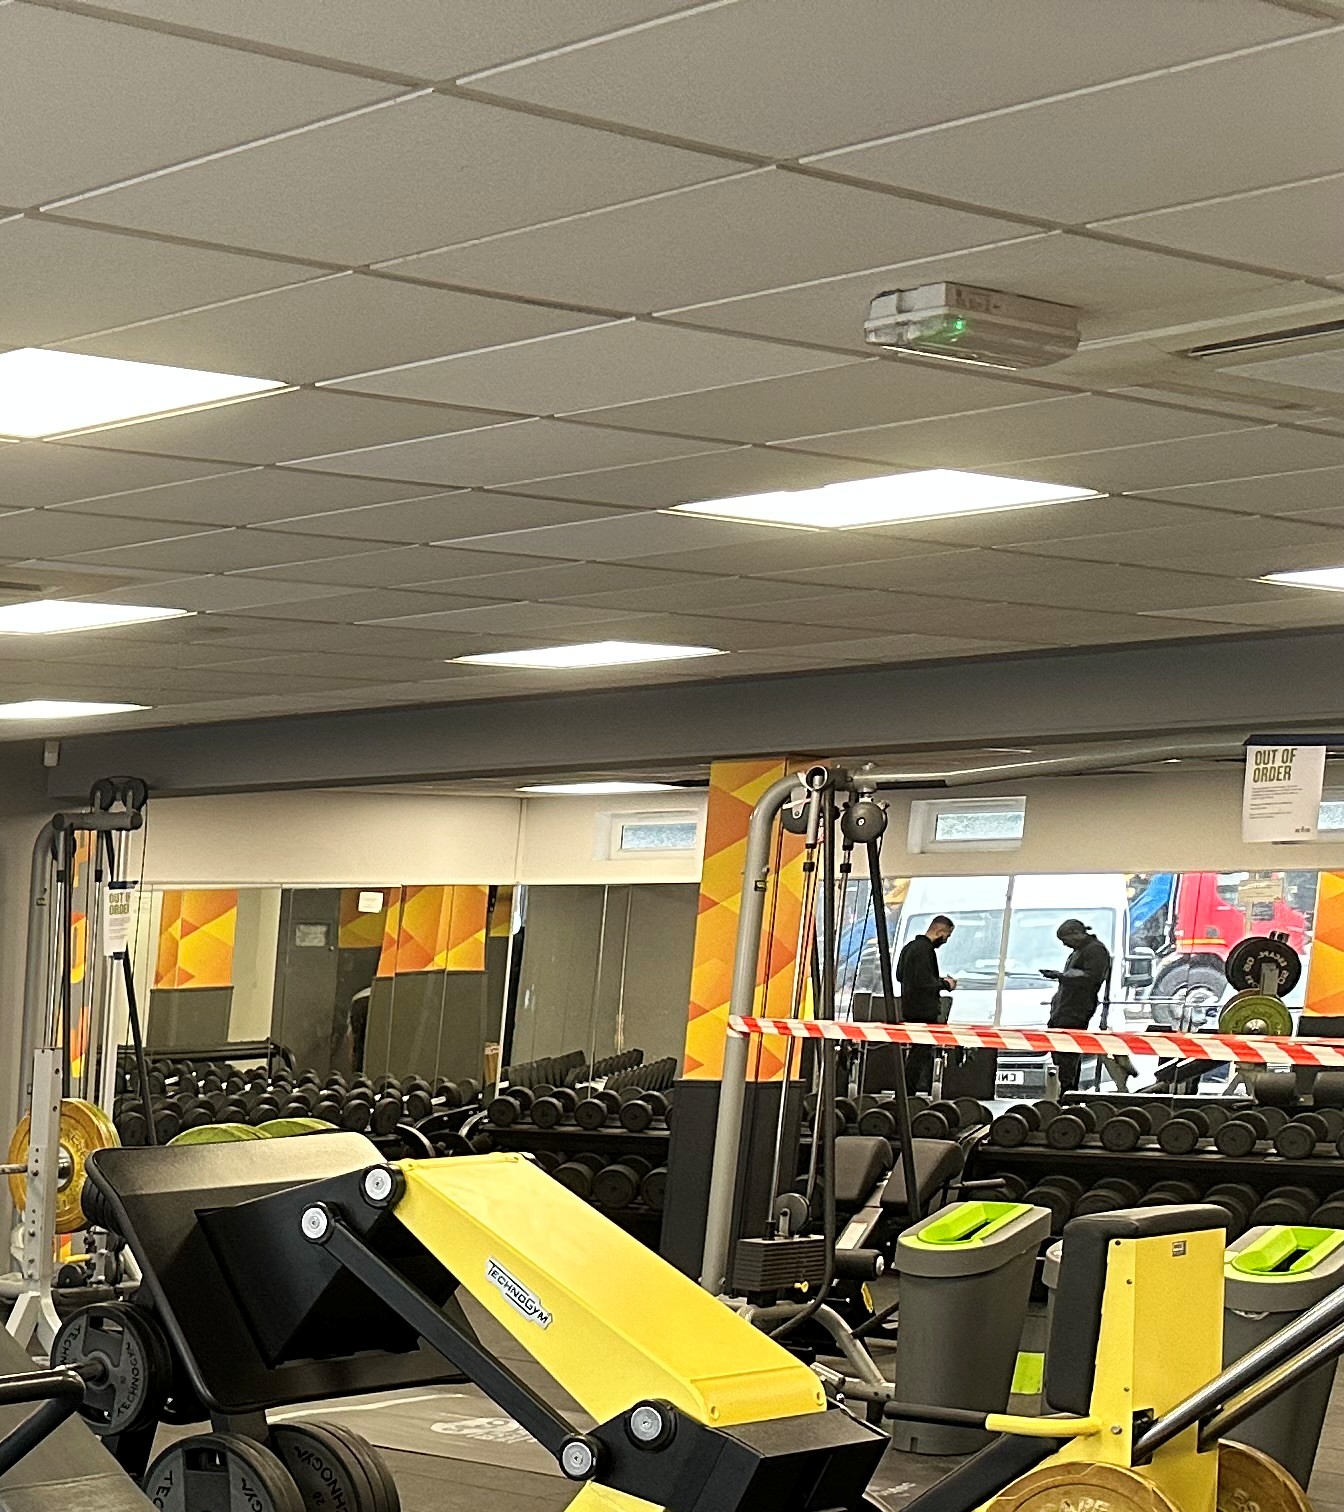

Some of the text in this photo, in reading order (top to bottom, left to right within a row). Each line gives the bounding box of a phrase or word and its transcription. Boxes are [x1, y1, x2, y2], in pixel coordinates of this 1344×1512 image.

[1254, 748, 1297, 766] OUT OF
[1252, 765, 1292, 783] ORDER
[487, 1259, 549, 1324] TECHNOGYM
